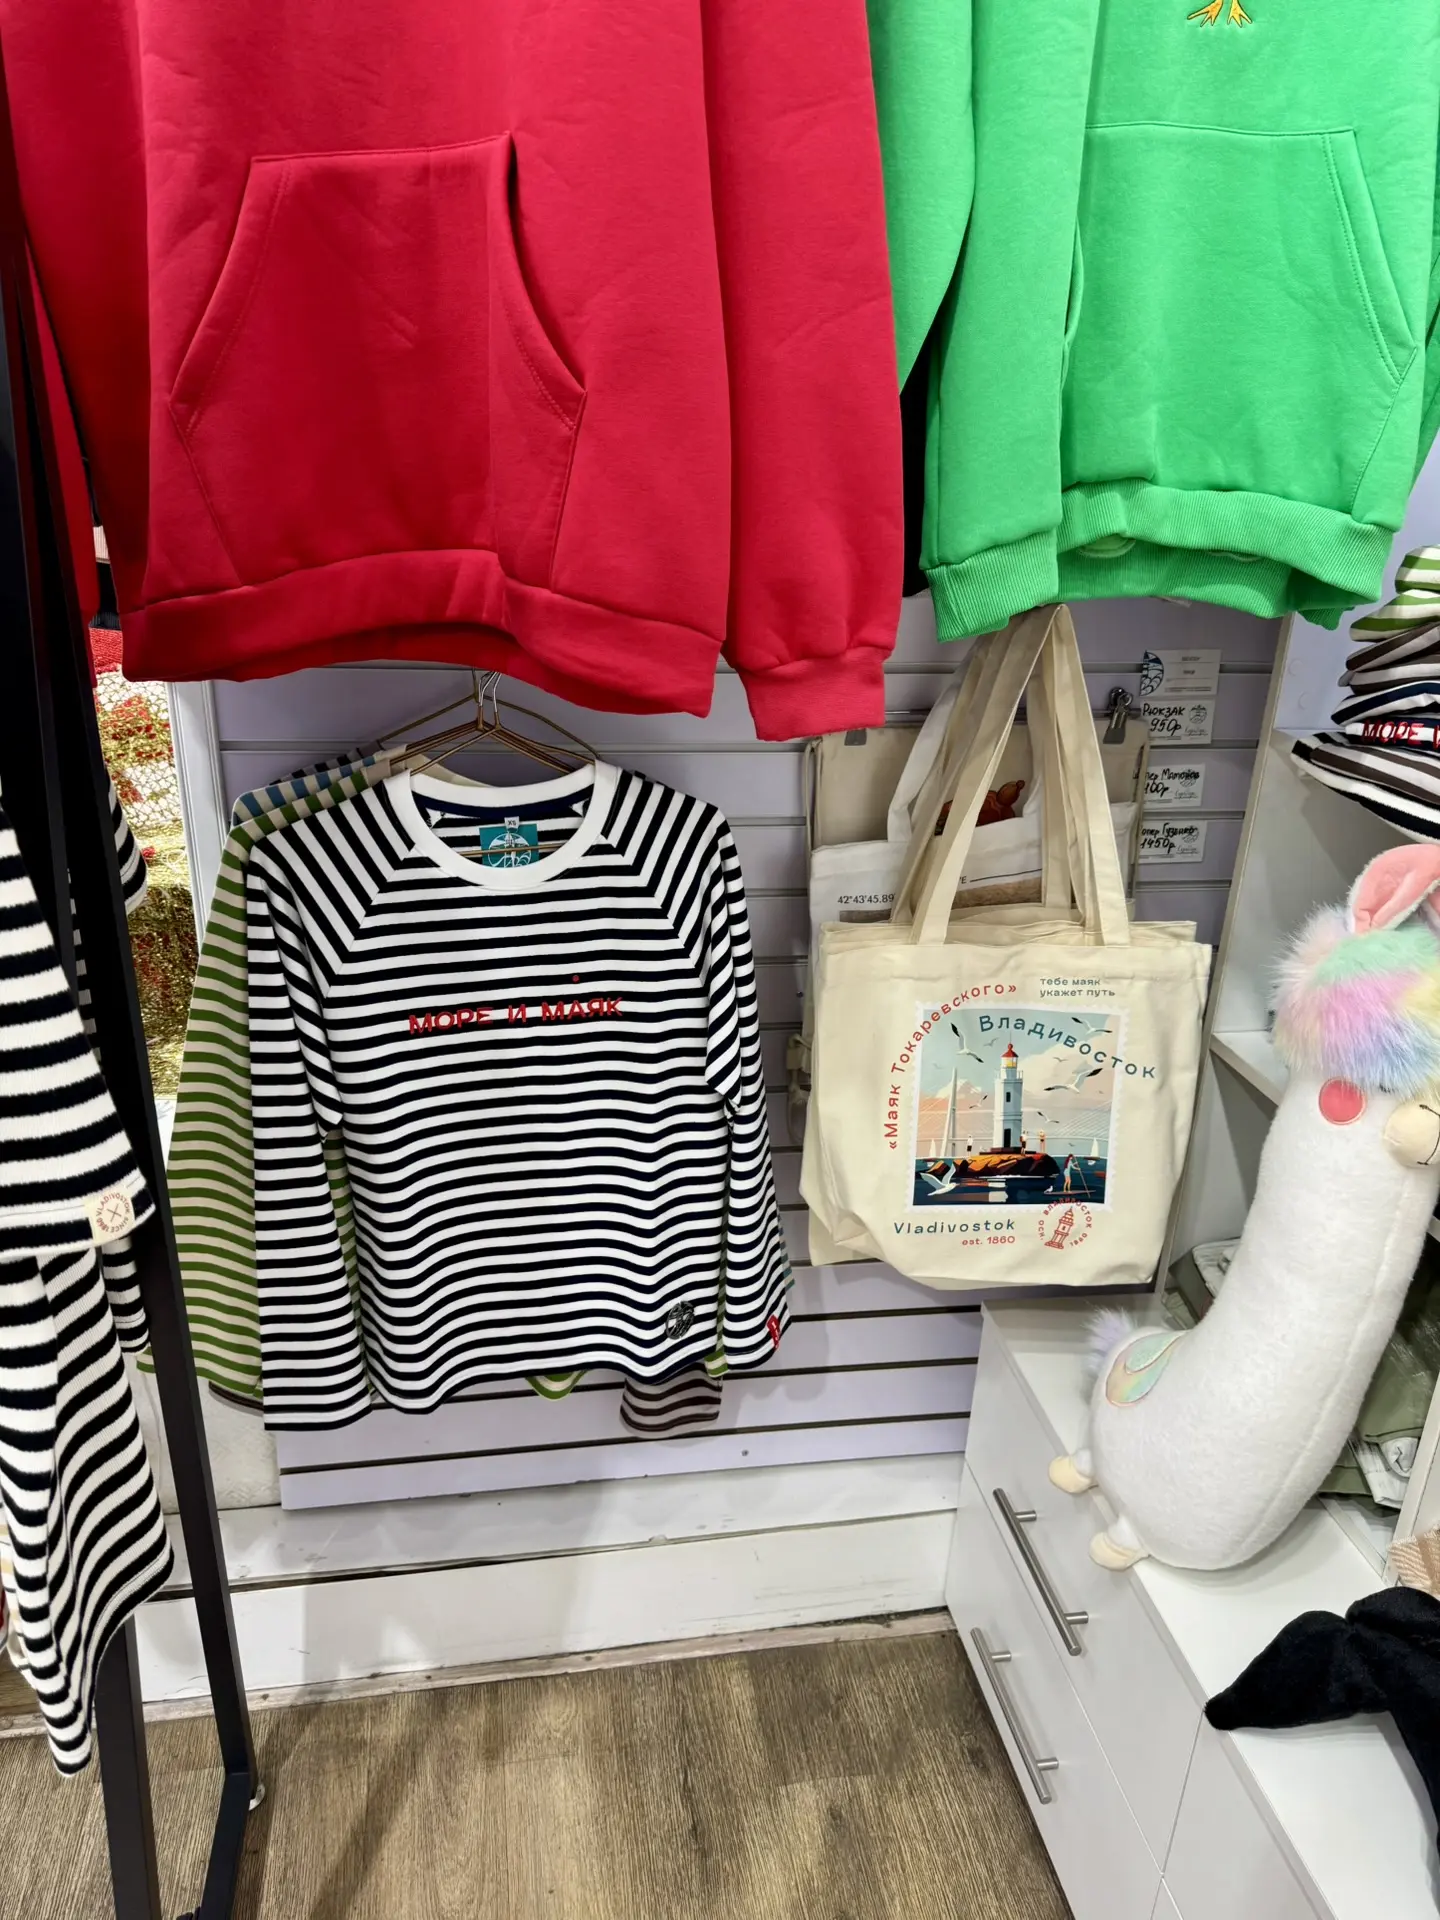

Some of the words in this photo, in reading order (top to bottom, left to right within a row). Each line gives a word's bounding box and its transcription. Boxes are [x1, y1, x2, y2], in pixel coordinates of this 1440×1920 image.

[1360, 720, 1425, 745] МОРЕ
[1040, 977, 1068, 986] тебе
[1040, 989, 1083, 998] укажет
[1086, 989, 1116, 997] путь
[408, 1006, 493, 1035] МОРЕ
[508, 1003, 527, 1023] И
[541, 997, 623, 1021] МАЯК
[891, 984, 1017, 1074] Токаревского»
[978, 1015, 1156, 1078] Владивосток
[884, 1083, 901, 1149] «Маяк
[894, 1218, 1015, 1234] Vladivostok
[961, 1238, 983, 1246] est.
[986, 1236, 1015, 1245] 1860
